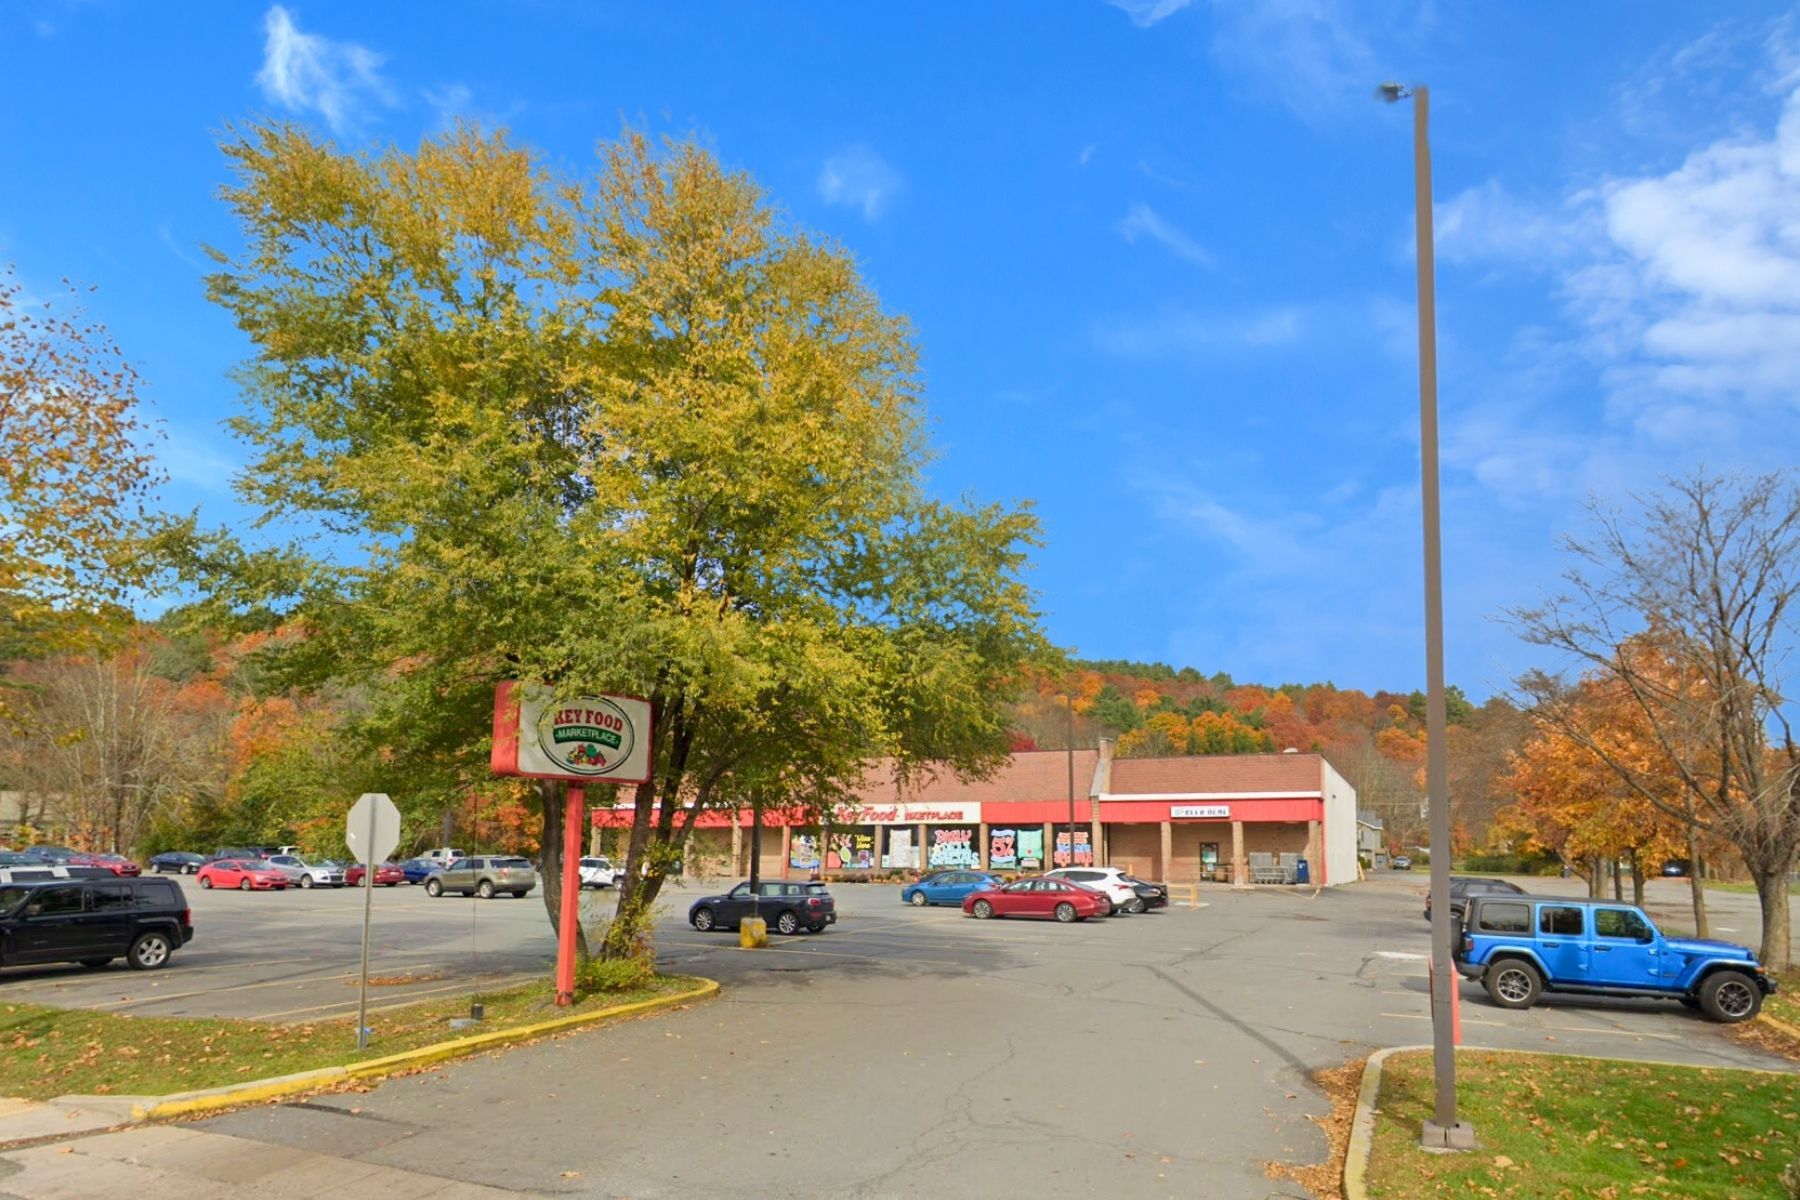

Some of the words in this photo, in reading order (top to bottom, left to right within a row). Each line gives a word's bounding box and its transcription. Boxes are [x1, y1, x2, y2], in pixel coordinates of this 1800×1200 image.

[554, 709, 582, 725] KEY
[585, 709, 623, 732] FOOD
[556, 728, 617, 741] MARKETPLACE
[861, 805, 897, 821] Food
